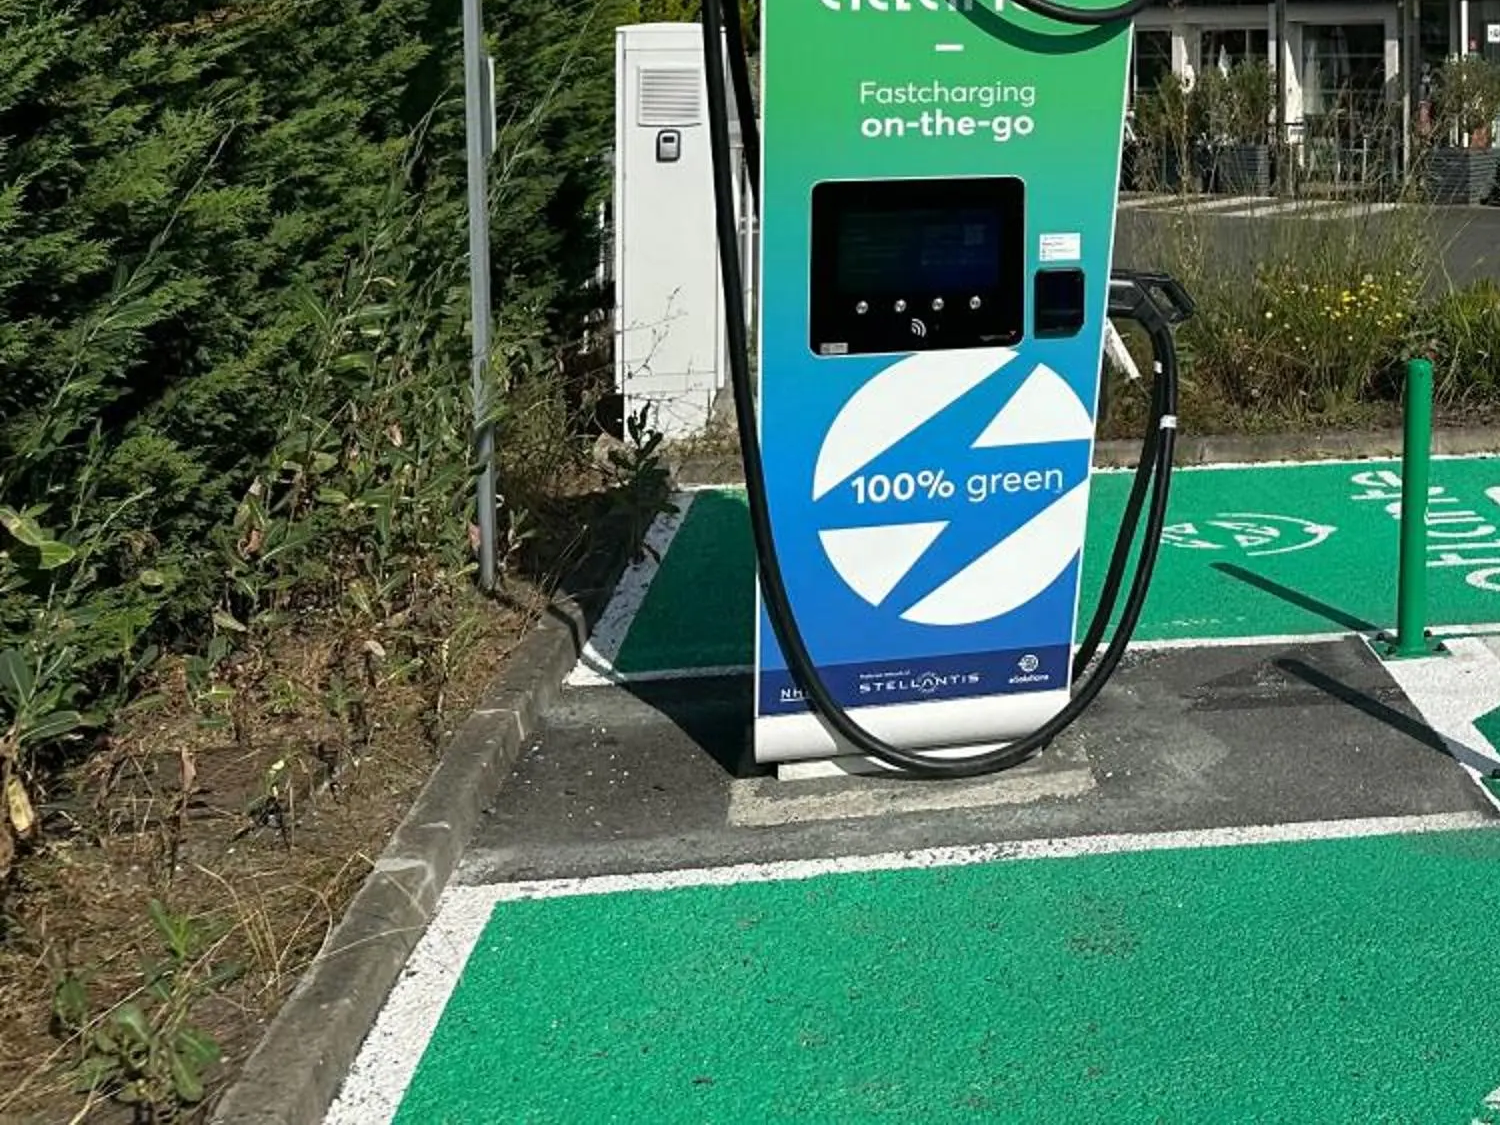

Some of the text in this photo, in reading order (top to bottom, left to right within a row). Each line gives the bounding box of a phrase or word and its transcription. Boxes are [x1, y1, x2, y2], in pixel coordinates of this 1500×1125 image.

[859, 80, 1036, 108] Fastcharging
[860, 110, 1034, 142] on-the-go
[851, 467, 1064, 504] 100% green
[859, 672, 980, 694] STELLANTIS
